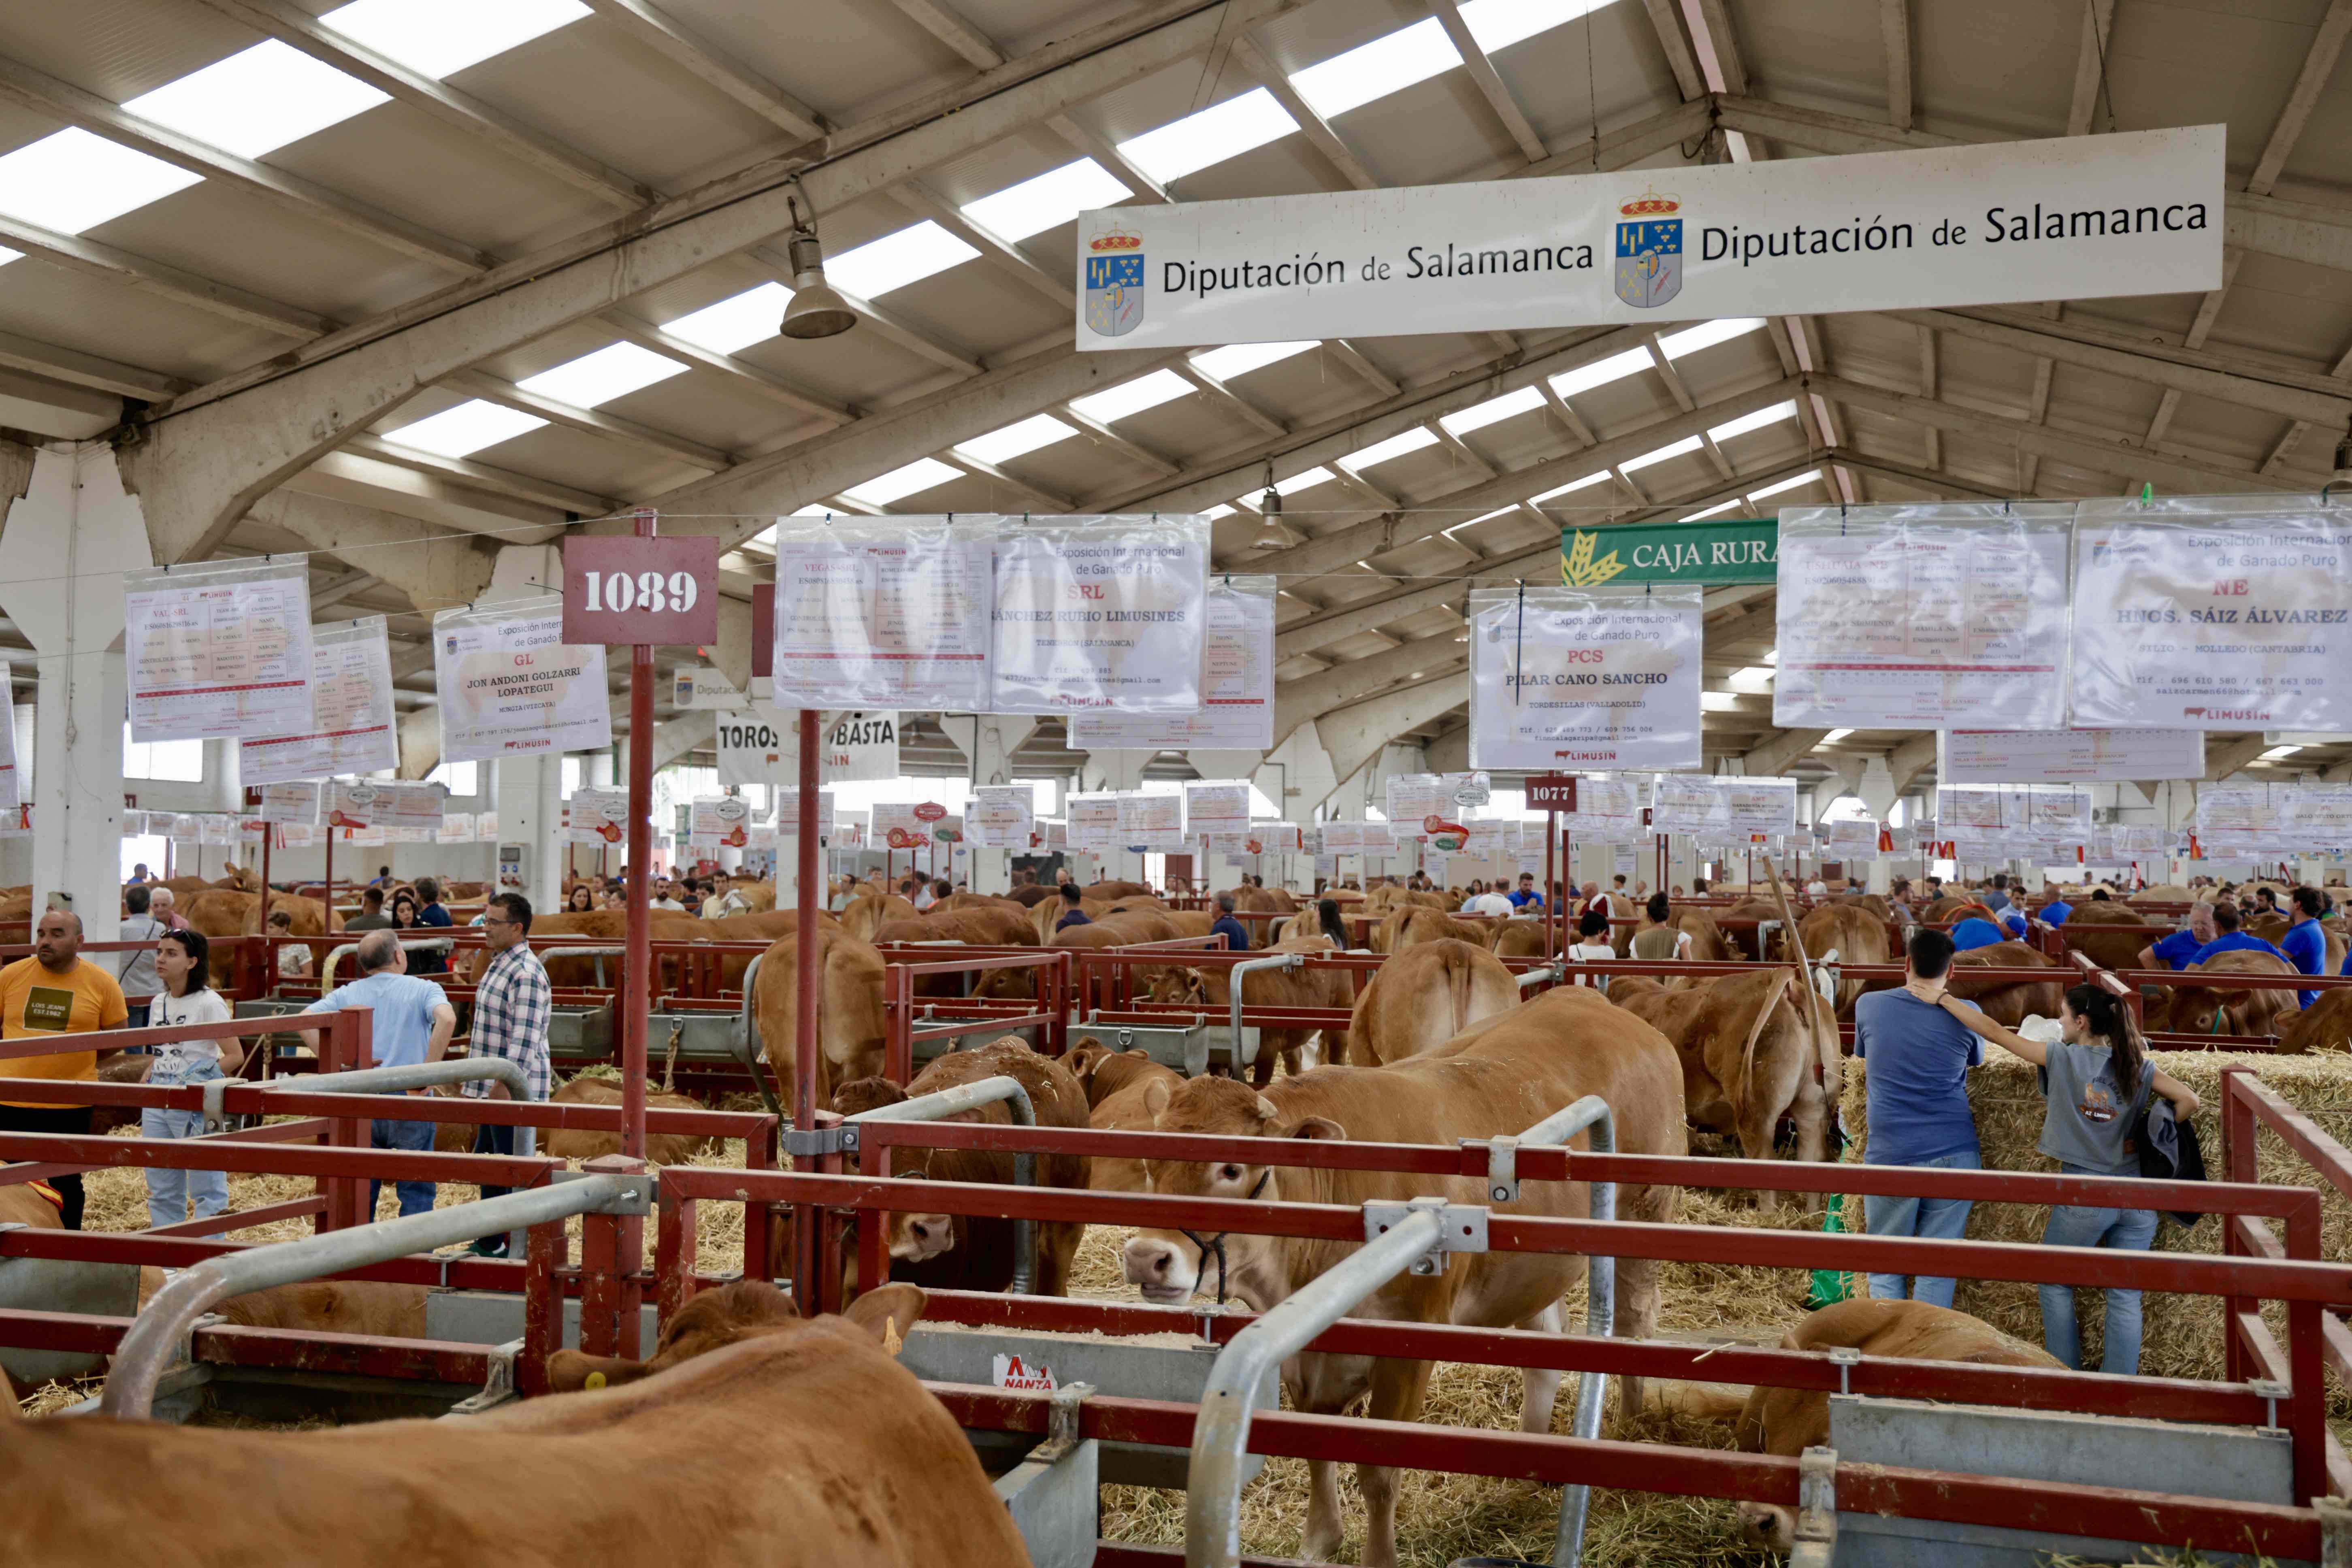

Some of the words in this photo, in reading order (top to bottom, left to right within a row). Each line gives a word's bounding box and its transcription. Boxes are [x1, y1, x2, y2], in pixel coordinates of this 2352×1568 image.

[1702, 215, 1913, 267] Diputación
[1932, 218, 1966, 247] de
[1985, 203, 2207, 244] Salamanca
[1163, 252, 1345, 299] Diputación
[1361, 256, 1391, 281] de
[1406, 242, 1594, 279] Salamanca
[2188, 535, 2265, 549] Exposición
[1056, 546, 1110, 560] Exposición
[1632, 544, 1702, 573] CAJA
[2217, 554, 2235, 567] de
[2239, 554, 2297, 567] Ganado
[2301, 554, 2338, 567] Puro
[1076, 565, 1089, 574] de
[1092, 565, 1132, 575] Ganado
[585, 571, 698, 613] 1089
[1067, 585, 1105, 600] SRL
[2212, 578, 2249, 596] NE
[208, 590, 233, 599] LIMUSIN
[1057, 611, 1101, 622] RUBIO
[1106, 611, 1185, 622] LIMUSINES
[1612, 613, 1681, 624] Internacional
[2189, 606, 2238, 624] SÁIZ
[2245, 607, 2348, 624] ÁLVAREZ
[499, 623, 540, 636] Exposición
[1574, 632, 1587, 641] de
[1591, 631, 1632, 641] Ganado
[1635, 630, 1660, 640] Puro
[515, 639, 525, 647] de
[527, 634, 557, 646] Ganado
[514, 654, 534, 667] GL
[1567, 650, 1604, 663] PCS
[467, 679, 488, 688] JON
[490, 674, 529, 686] ANDONI
[532, 667, 581, 681] GOLZARRI
[1506, 674, 1550, 686] PILAR
[1555, 674, 1597, 685] CANO
[1602, 673, 1668, 685] SANCHO
[497, 683, 554, 698] LOPATEGUI
[2207, 710, 2270, 720] LIMUSIN
[517, 739, 552, 749] LIMUSIN
[1571, 752, 1616, 761] LIMUSIN
[1532, 787, 1570, 801] 1077
[1004, 1378, 1052, 1390] NANTA
